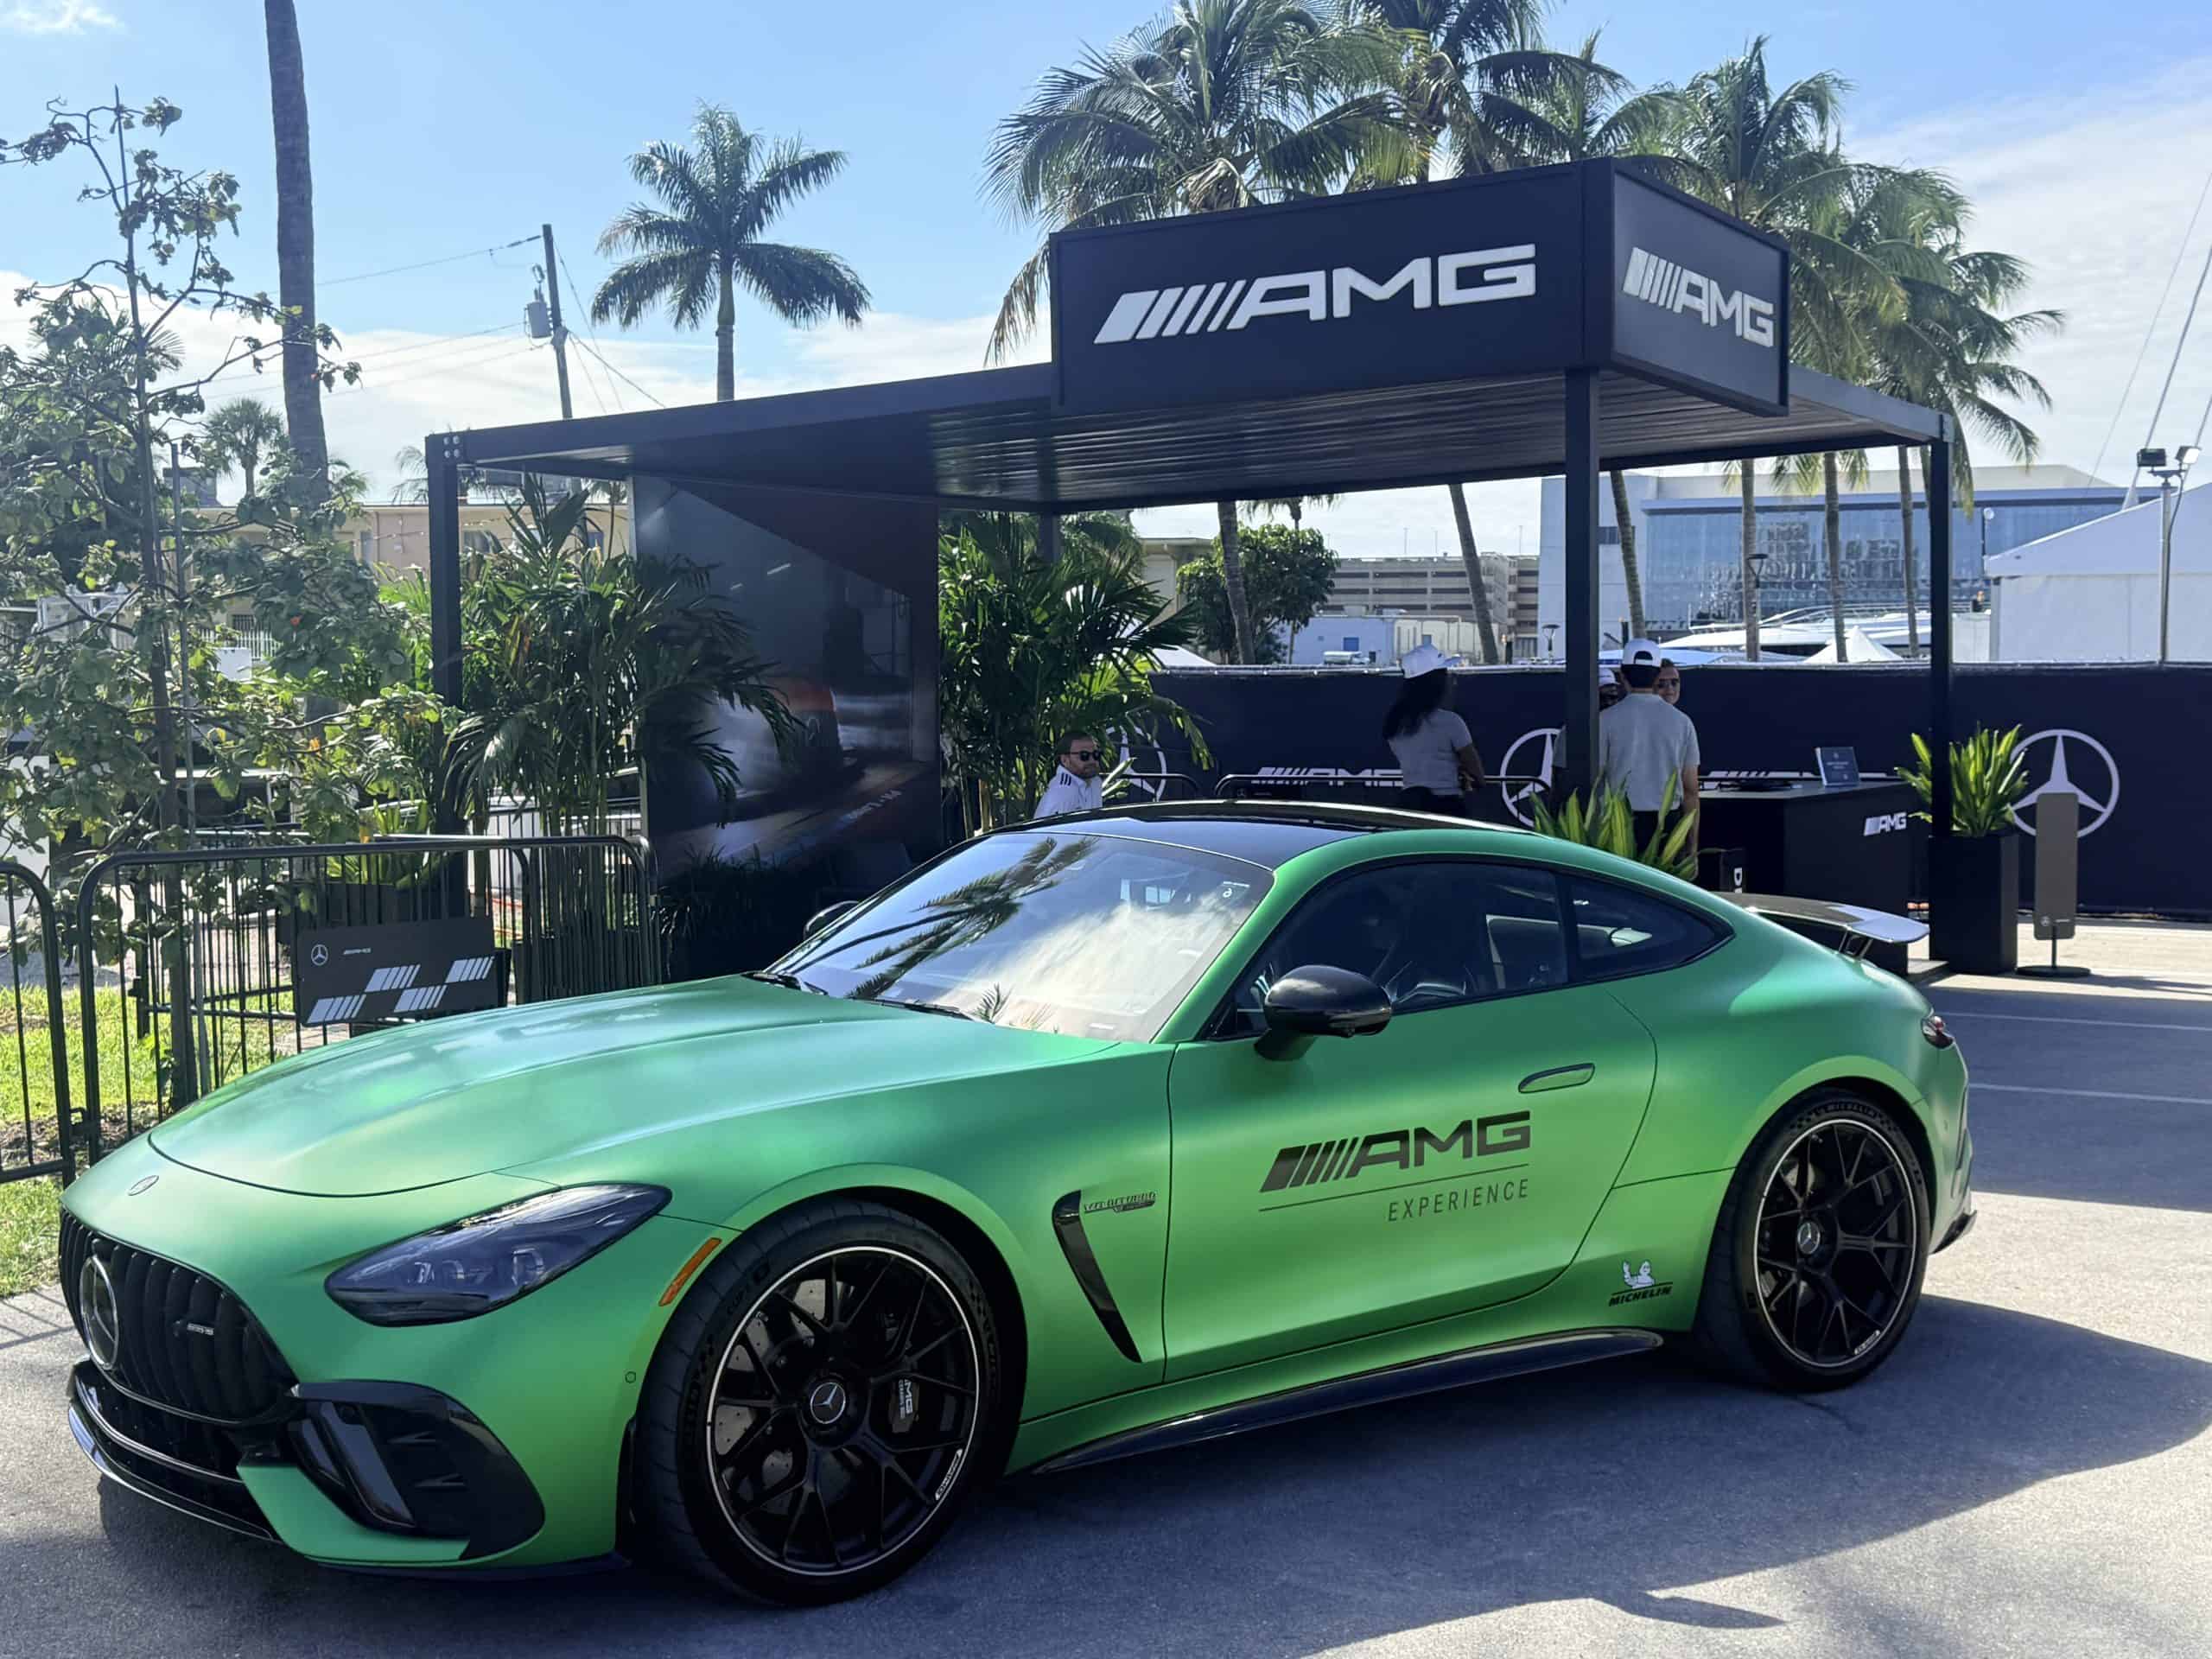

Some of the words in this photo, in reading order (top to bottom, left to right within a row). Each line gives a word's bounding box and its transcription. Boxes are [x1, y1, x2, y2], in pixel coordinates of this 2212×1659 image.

[1227, 243, 1536, 330] AMG
[1673, 268, 1774, 347] AMG
[1878, 812, 1907, 833] AMG
[1345, 1110, 1531, 1179] AMG
[1388, 1179, 1529, 1222] EXPERIENCE
[1608, 1285, 1673, 1306] MICHELIN
